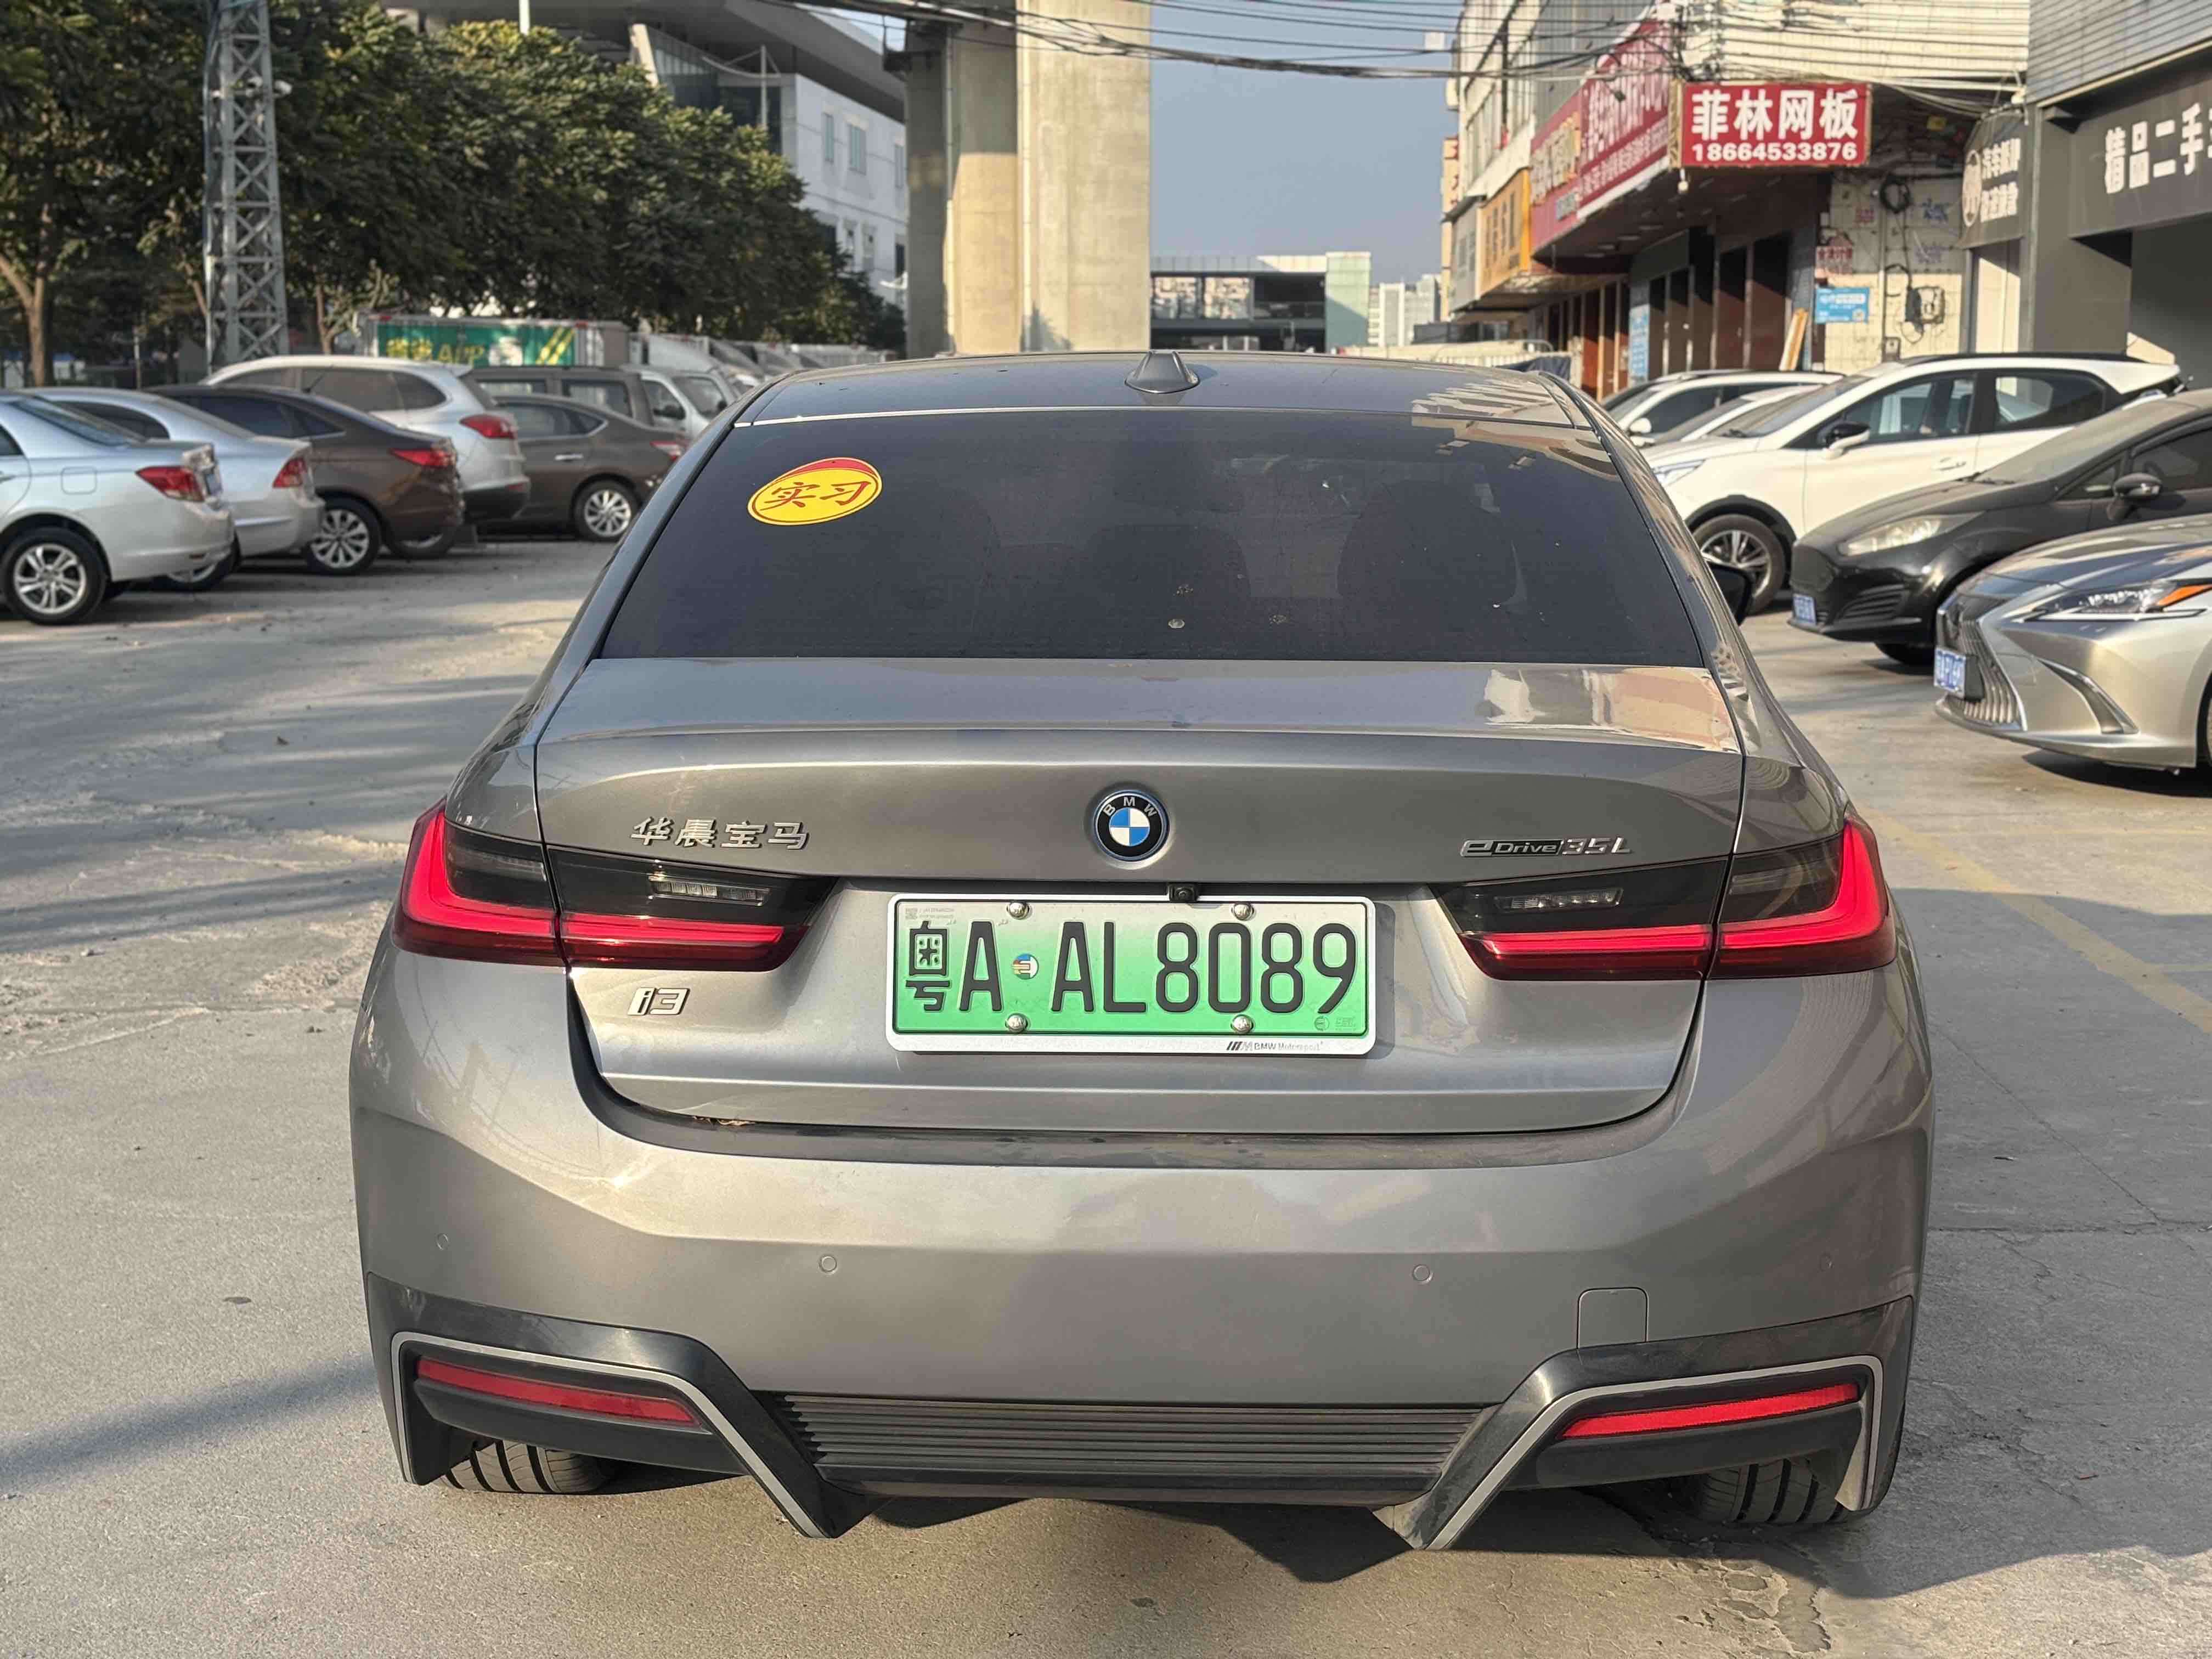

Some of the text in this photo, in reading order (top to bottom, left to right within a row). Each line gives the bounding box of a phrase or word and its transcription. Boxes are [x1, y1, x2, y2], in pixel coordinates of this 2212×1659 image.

[1691, 88, 1858, 141] 菲林网板
[1691, 142, 1858, 162] 18664533876
[2104, 101, 2212, 195] 精品二手
[759, 481, 872, 511] 实习
[1102, 796, 1158, 817] BMW
[630, 816, 810, 850] 华晨宝马
[905, 921, 1357, 1014] 粤A AL8089
[628, 987, 691, 1015] i3
[1254, 1042, 1276, 1050] BMW
